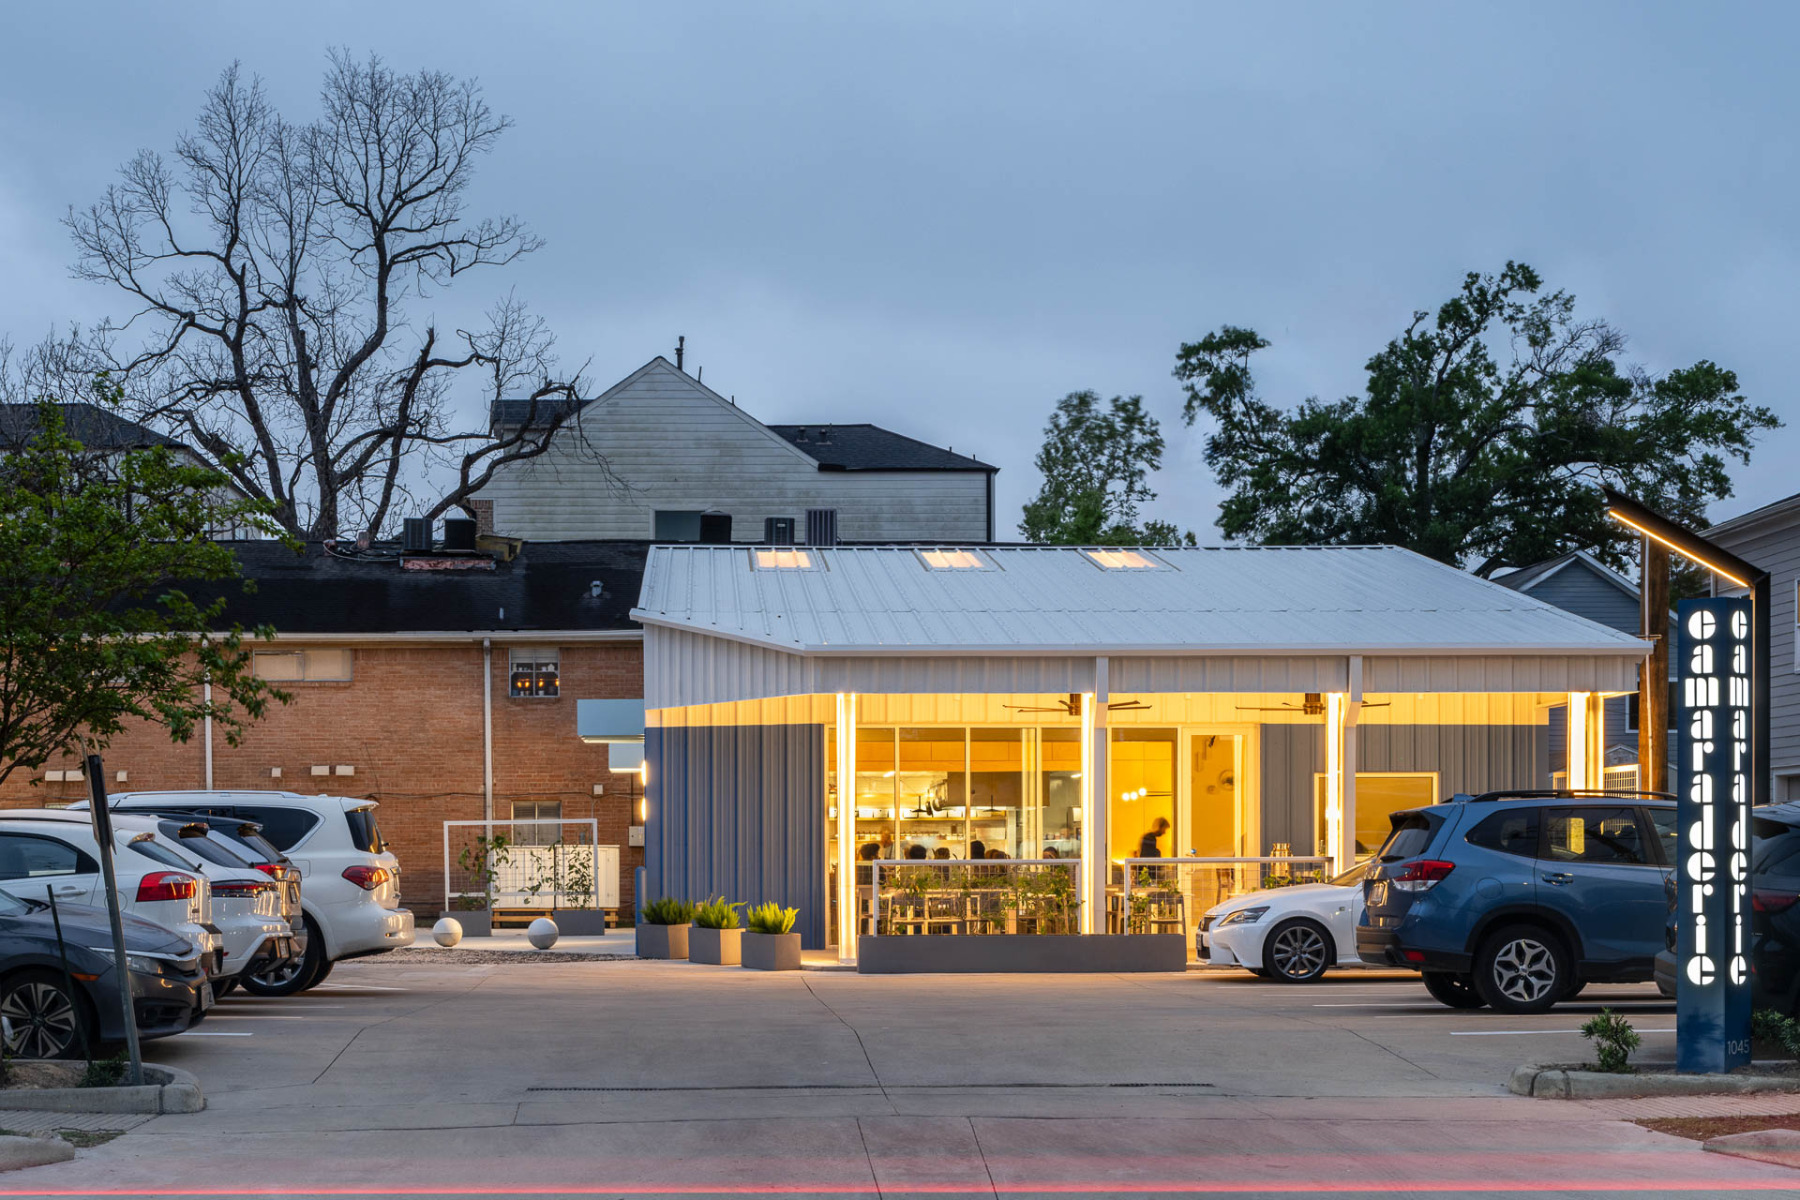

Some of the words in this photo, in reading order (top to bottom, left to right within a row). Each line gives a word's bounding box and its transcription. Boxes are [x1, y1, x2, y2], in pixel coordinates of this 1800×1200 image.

[1685, 611, 1719, 985] camaraderie
[1730, 611, 1748, 985] camaraderie
[1727, 1039, 1750, 1055] 1045
